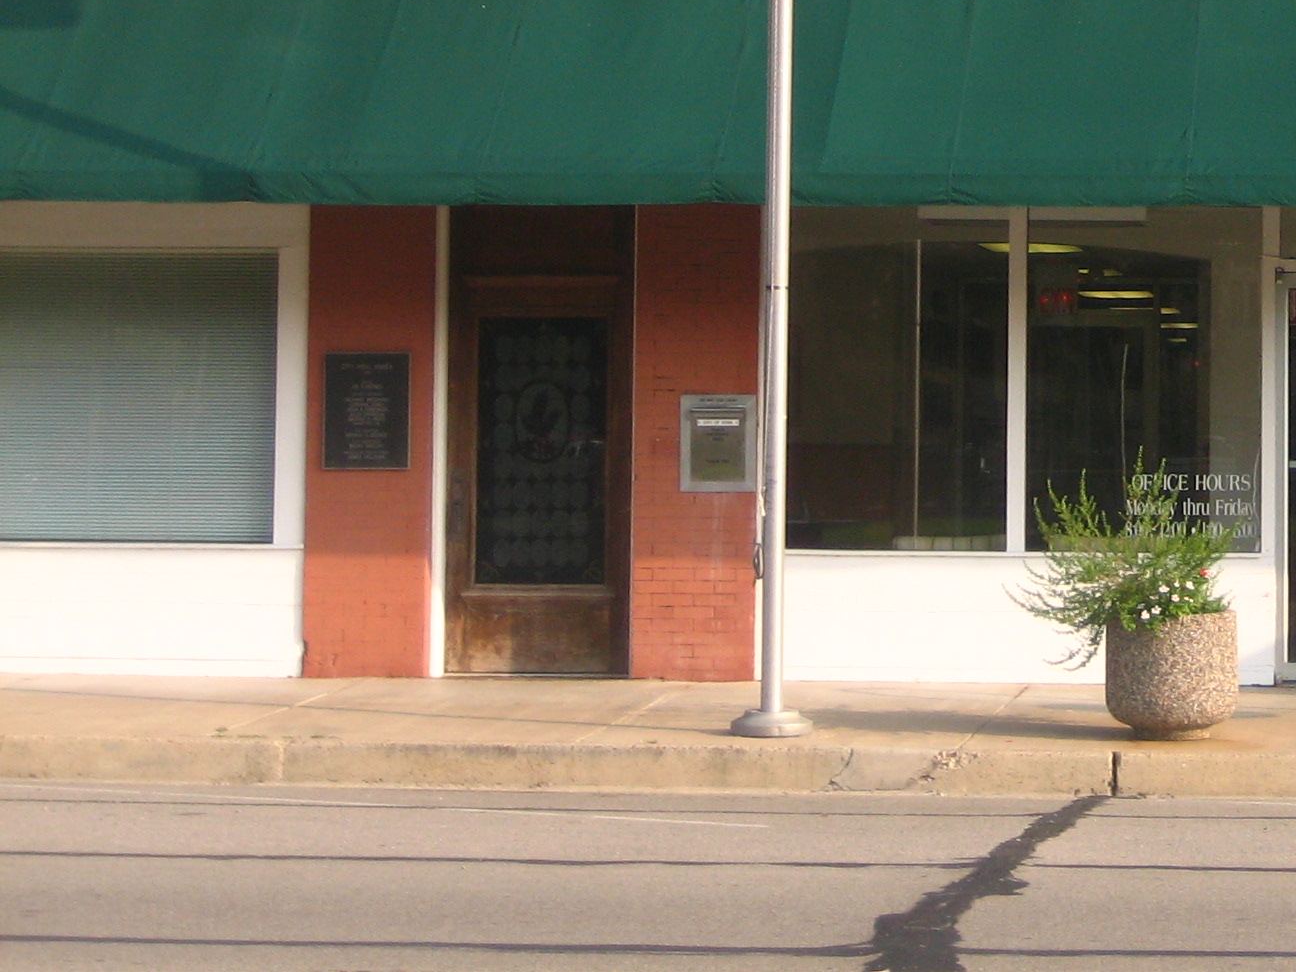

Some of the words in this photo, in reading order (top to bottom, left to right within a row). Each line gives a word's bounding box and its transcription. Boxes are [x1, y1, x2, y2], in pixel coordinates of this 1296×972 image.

[1132, 474, 1189, 492] OFICE
[1195, 474, 1251, 491] HOURS
[1126, 499, 1178, 520] Mody
[1182, 498, 1210, 516] thru
[1215, 498, 1257, 520] Friday
